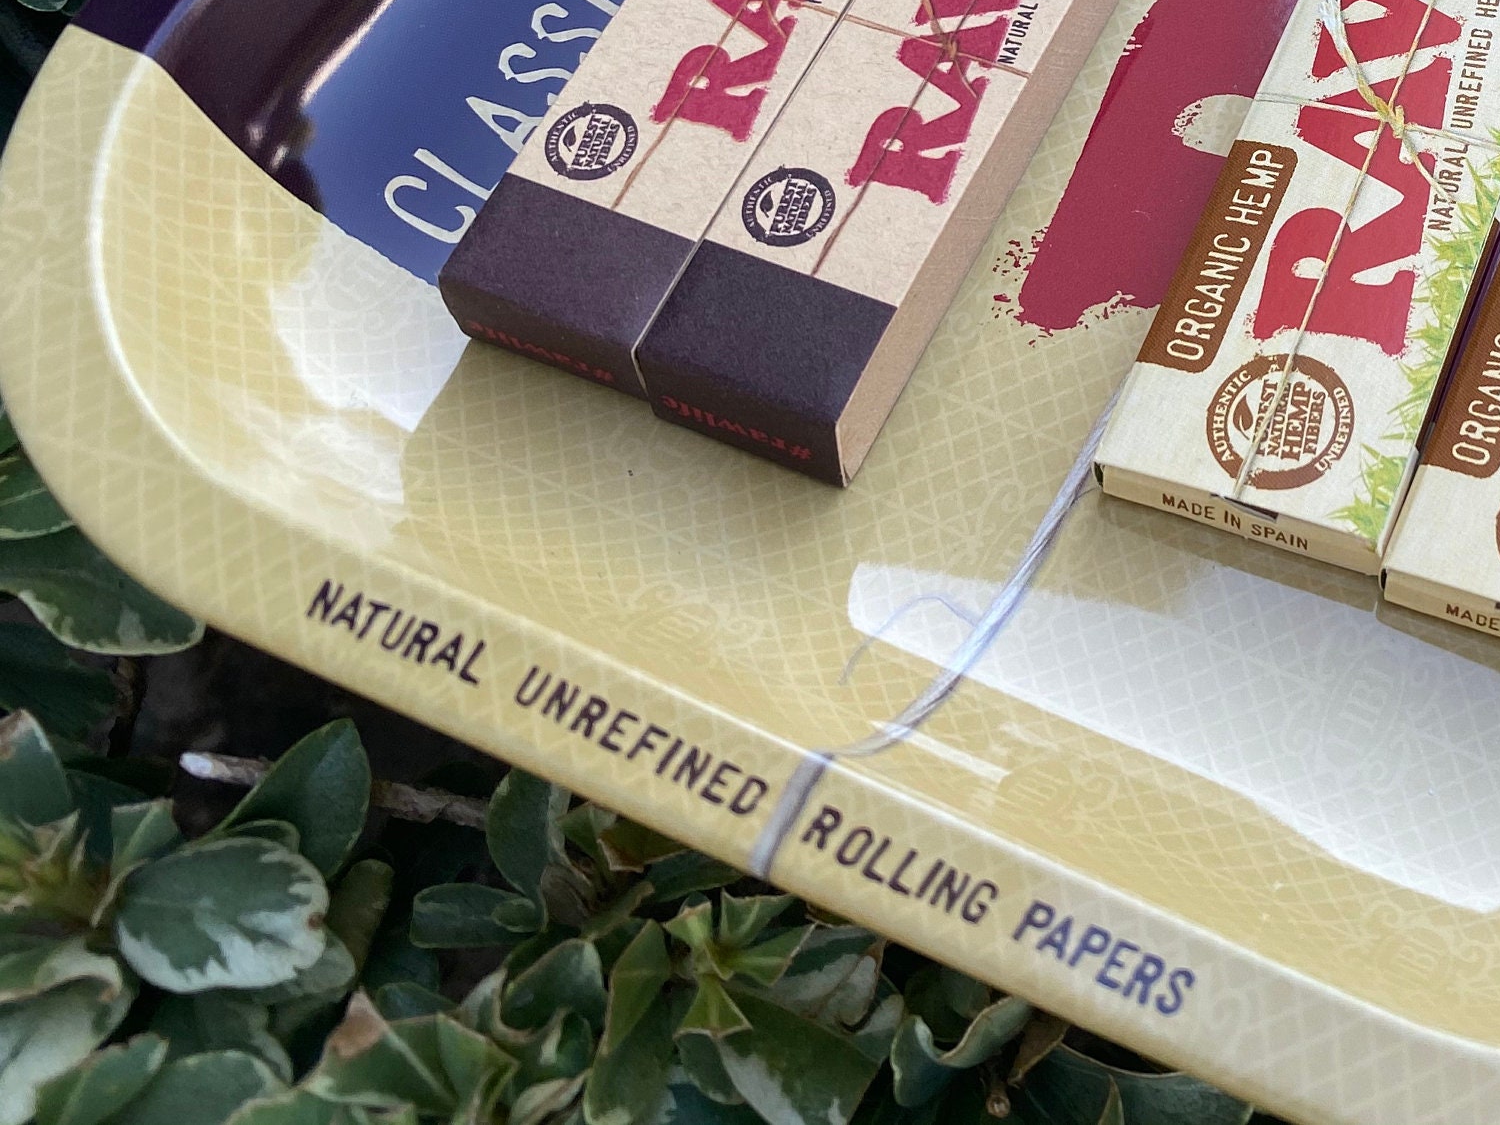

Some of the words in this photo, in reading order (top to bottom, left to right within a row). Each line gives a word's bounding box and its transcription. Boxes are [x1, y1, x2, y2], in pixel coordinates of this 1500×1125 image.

[998, 2, 1039, 65] NATURAL
[1427, 142, 1470, 232] NATURAL
[1450, 26, 1494, 131] UNREFINED
[1166, 232, 1250, 362] ORGANIC
[1225, 148, 1285, 228] HEMP
[660, 395, 812, 460] #rawlife
[1213, 370, 1251, 462] AUTHENTIC
[1280, 381, 1312, 461] HEMP
[1303, 389, 1327, 456] FIBERS
[1314, 386, 1351, 472] UNREFINED
[1162, 493, 1215, 520] MADE
[1223, 510, 1241, 531] IN
[1250, 524, 1308, 551] SPAIN
[1446, 603, 1500, 632] MADE
[306, 579, 487, 687] NATURAL
[513, 665, 770, 816] UNREFINED
[800, 805, 1000, 925] ROLLING
[1013, 900, 1196, 1016] PAPERS
